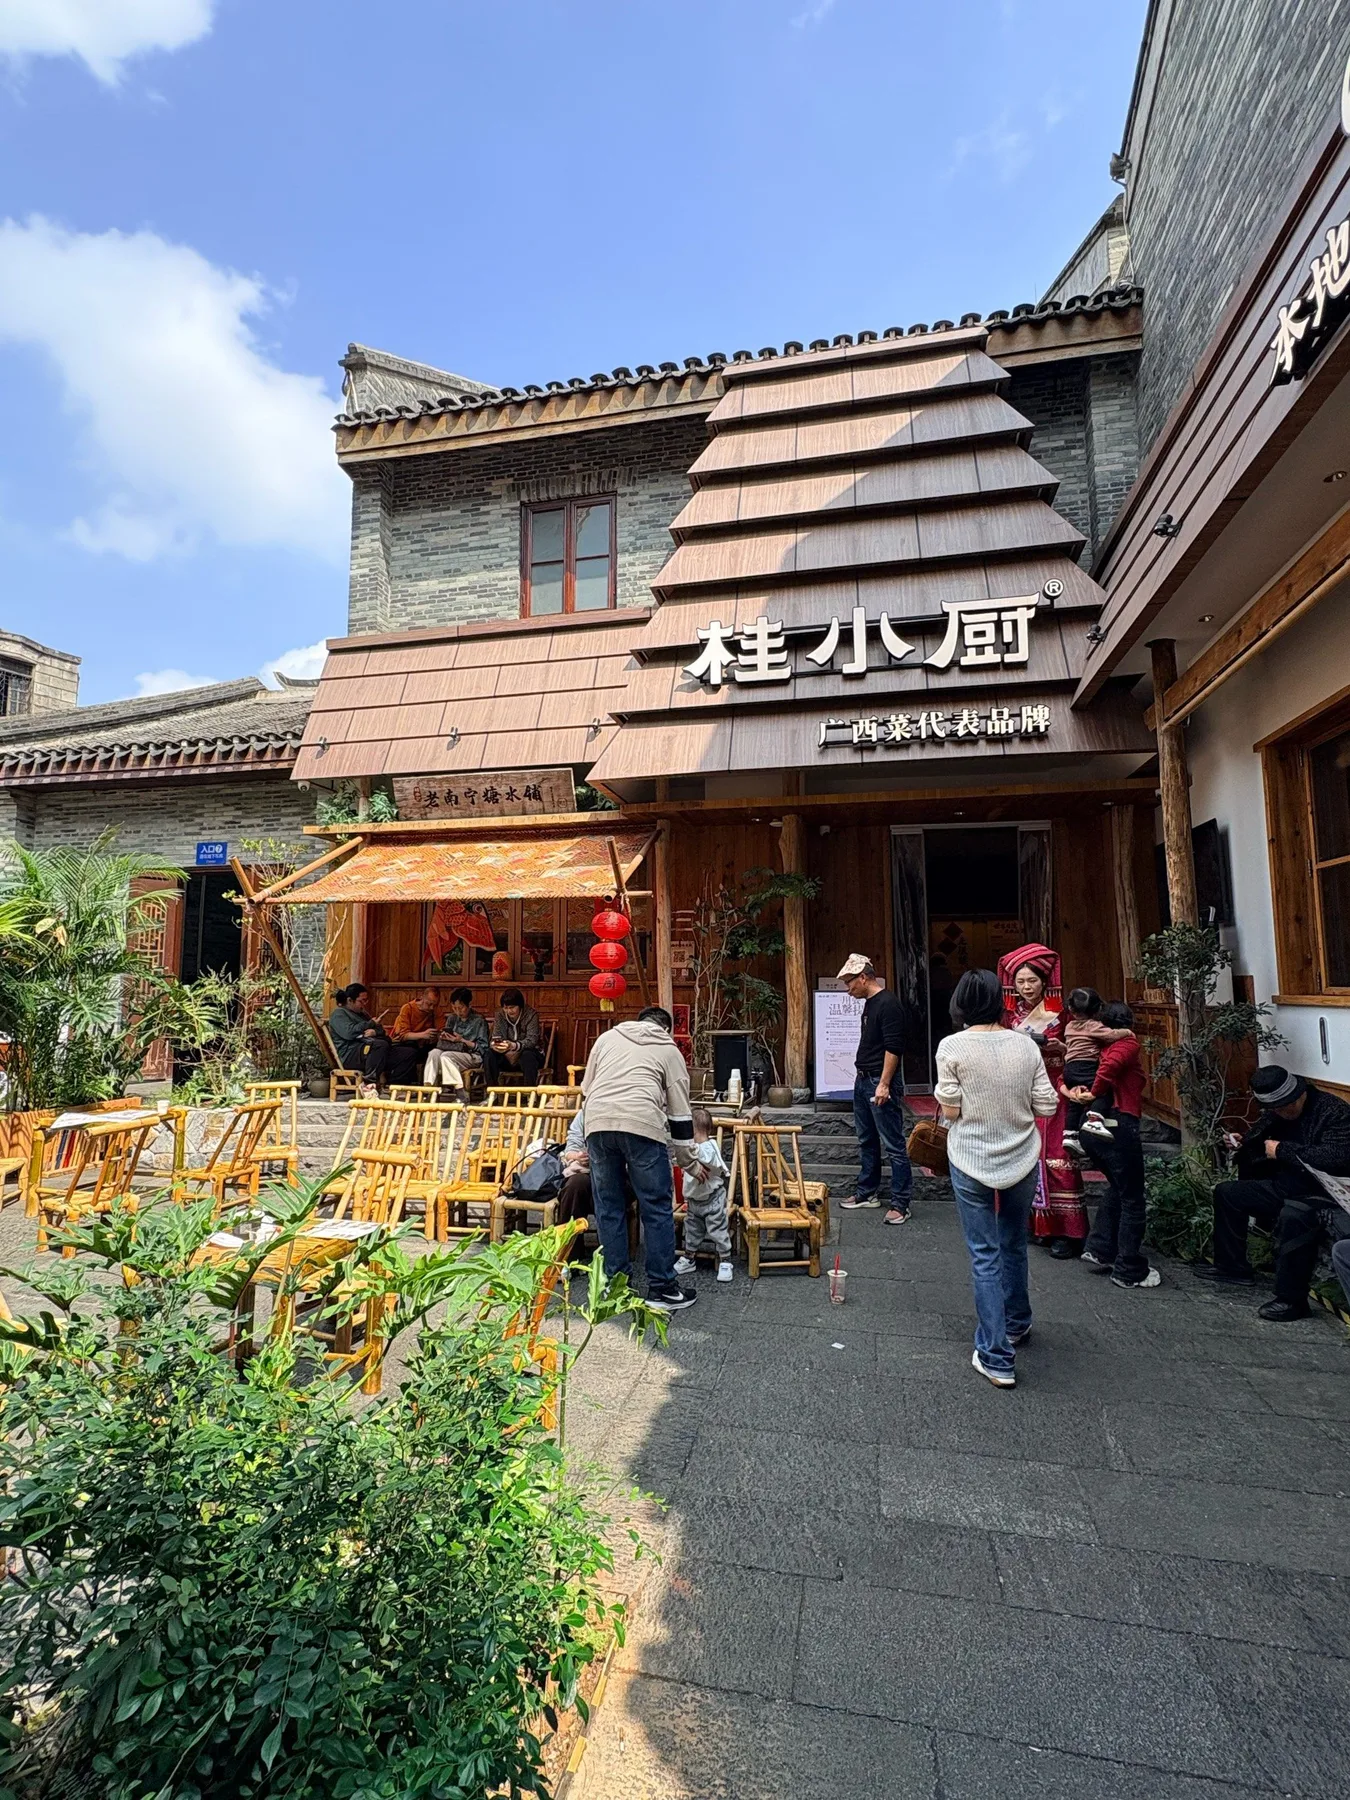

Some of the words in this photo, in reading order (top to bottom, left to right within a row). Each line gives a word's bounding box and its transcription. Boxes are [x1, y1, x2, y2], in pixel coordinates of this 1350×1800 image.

[1269, 220, 1350, 387] 本地
[683, 592, 1041, 686] 桂小厨
[817, 704, 1052, 748] 广西菜代表品牌
